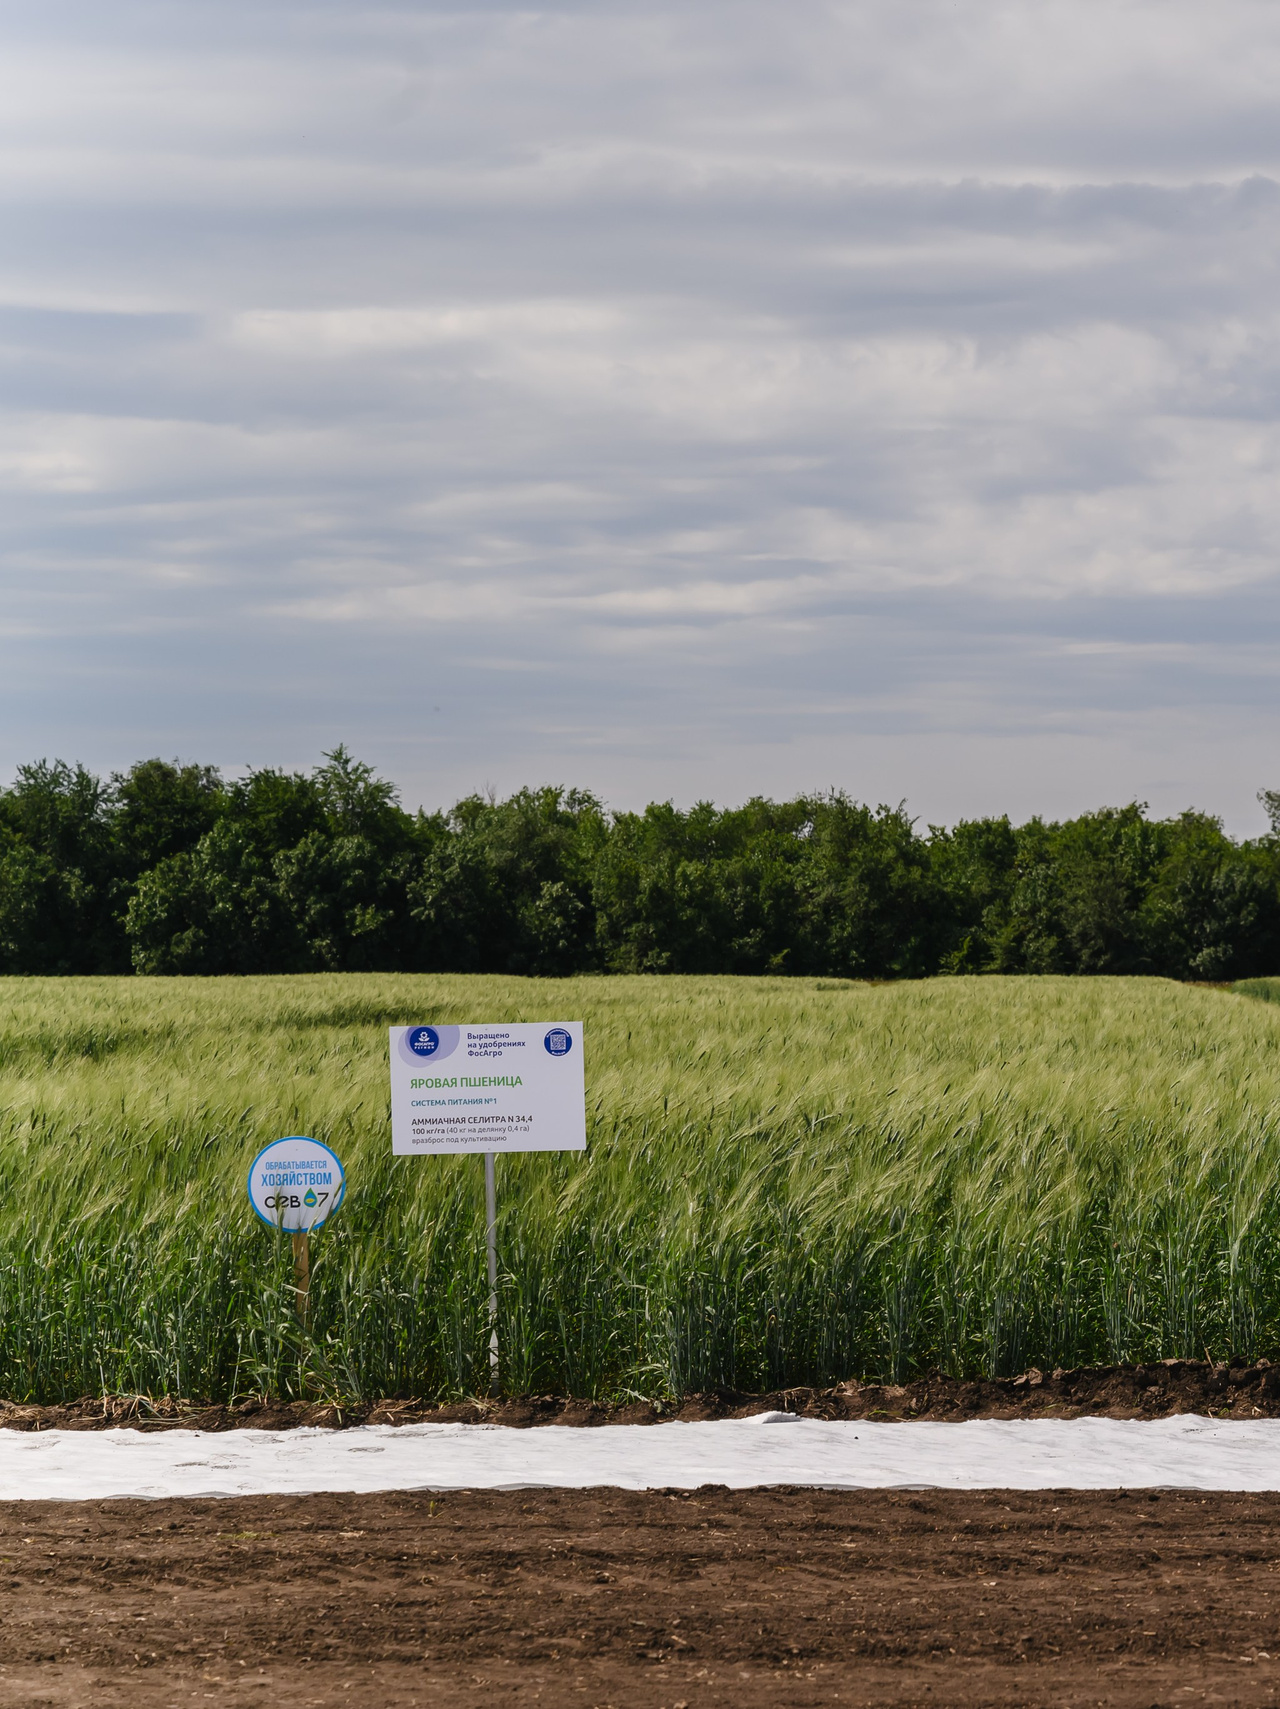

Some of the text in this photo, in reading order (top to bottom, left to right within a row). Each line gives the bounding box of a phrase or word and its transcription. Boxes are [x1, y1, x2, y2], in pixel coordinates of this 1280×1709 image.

[467, 1032, 510, 1041] Выращено
[478, 1040, 526, 1049] удобрениях
[410, 1076, 523, 1089] ЯРОВАЯ ПШЕНИЦА
[411, 1099, 446, 1107] СИСТЕМА
[411, 1117, 466, 1126] АММИАЧНАЯ
[468, 1116, 506, 1124] СЕЛИТРА
[515, 1115, 533, 1124] 34,4
[477, 1126, 506, 1134] делянку
[412, 1137, 444, 1145] вразброс
[461, 1135, 506, 1143] культивацию
[266, 1161, 327, 1170] ОБРАБАТЫВАЕТСЯ
[261, 1171, 332, 1186] ХОЗЯЙСТВОМ
